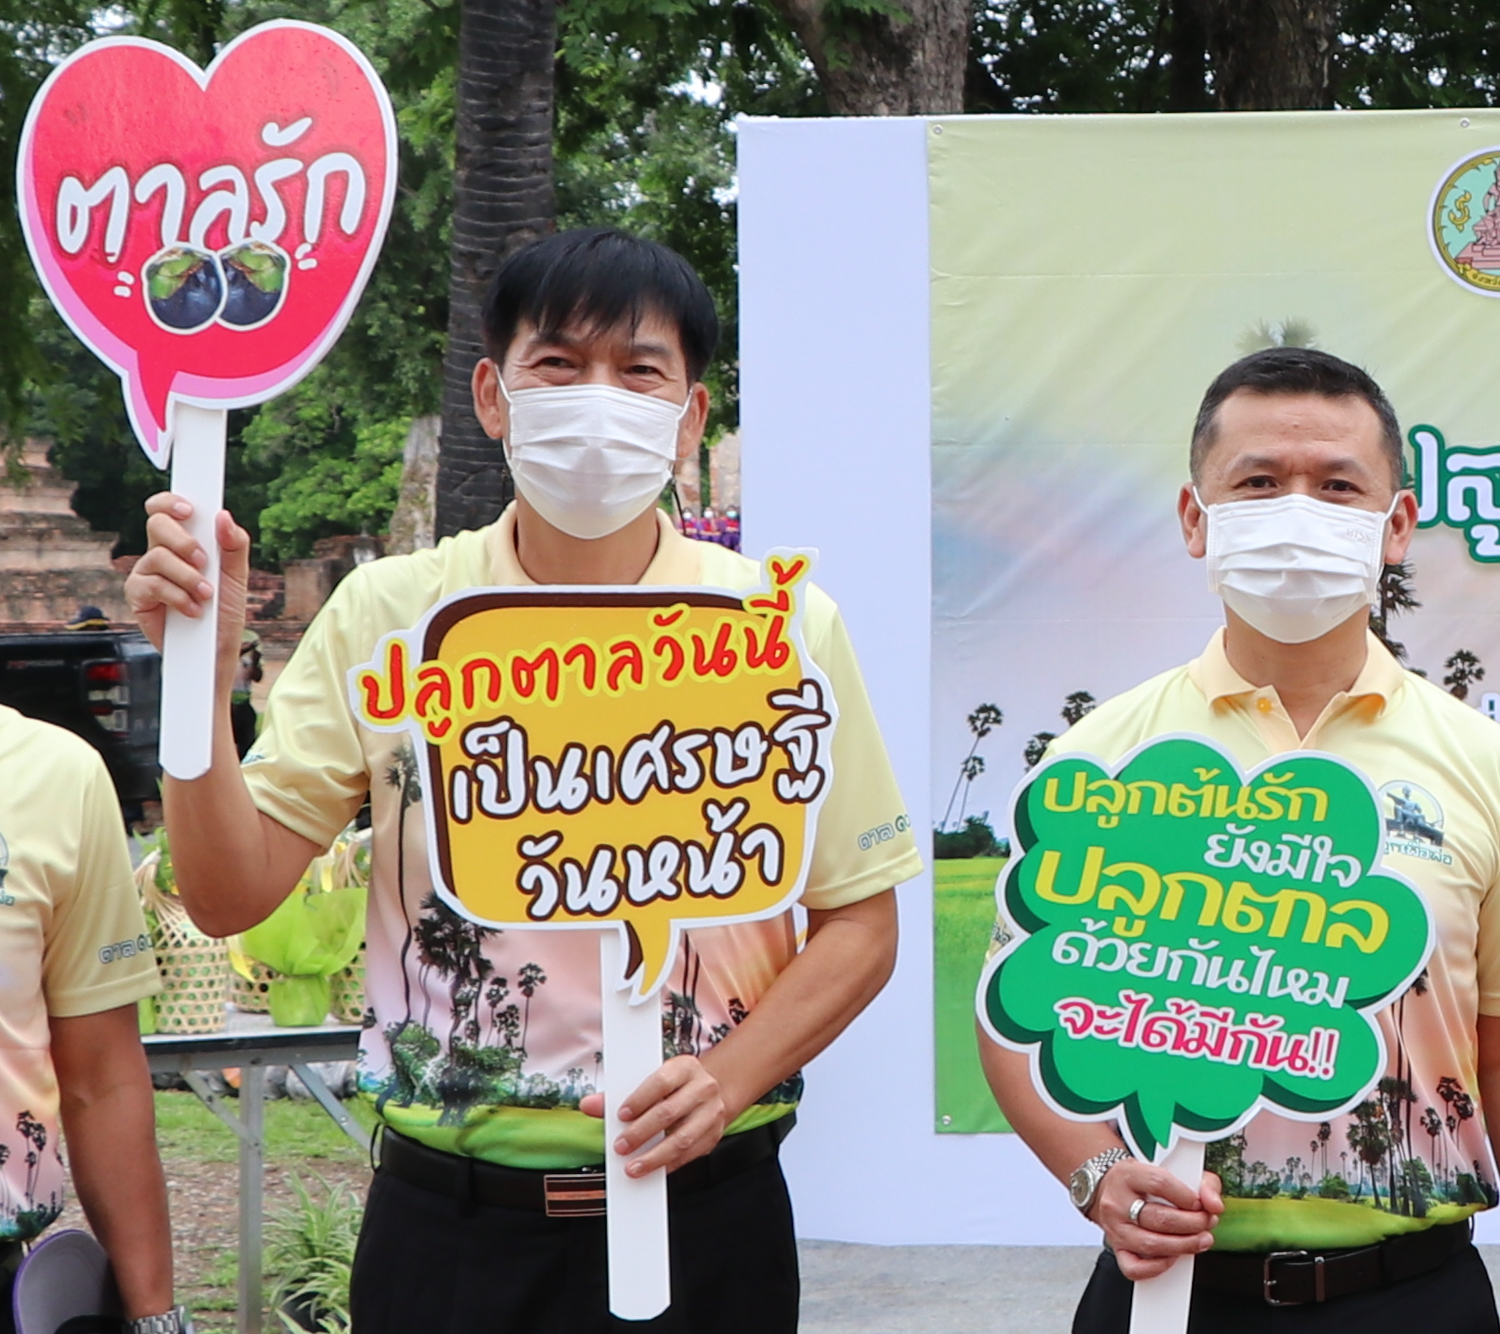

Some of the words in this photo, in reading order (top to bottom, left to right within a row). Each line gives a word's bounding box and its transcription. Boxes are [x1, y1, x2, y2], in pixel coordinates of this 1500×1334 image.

[56, 117, 367, 263] ตาลรัก
[362, 559, 804, 738] ปลูกตาลวันนี้
[452, 681, 829, 820] เป็นเศรษฐี
[1043, 767, 1328, 828] ปลูกต้นรัก
[521, 802, 781, 919] วันหน้า
[1204, 823, 1362, 888] ยังมีใจ
[1051, 918, 1349, 1009] ด้วยกันไหม
[1055, 992, 1340, 1080] จะได้มีกัน!!
